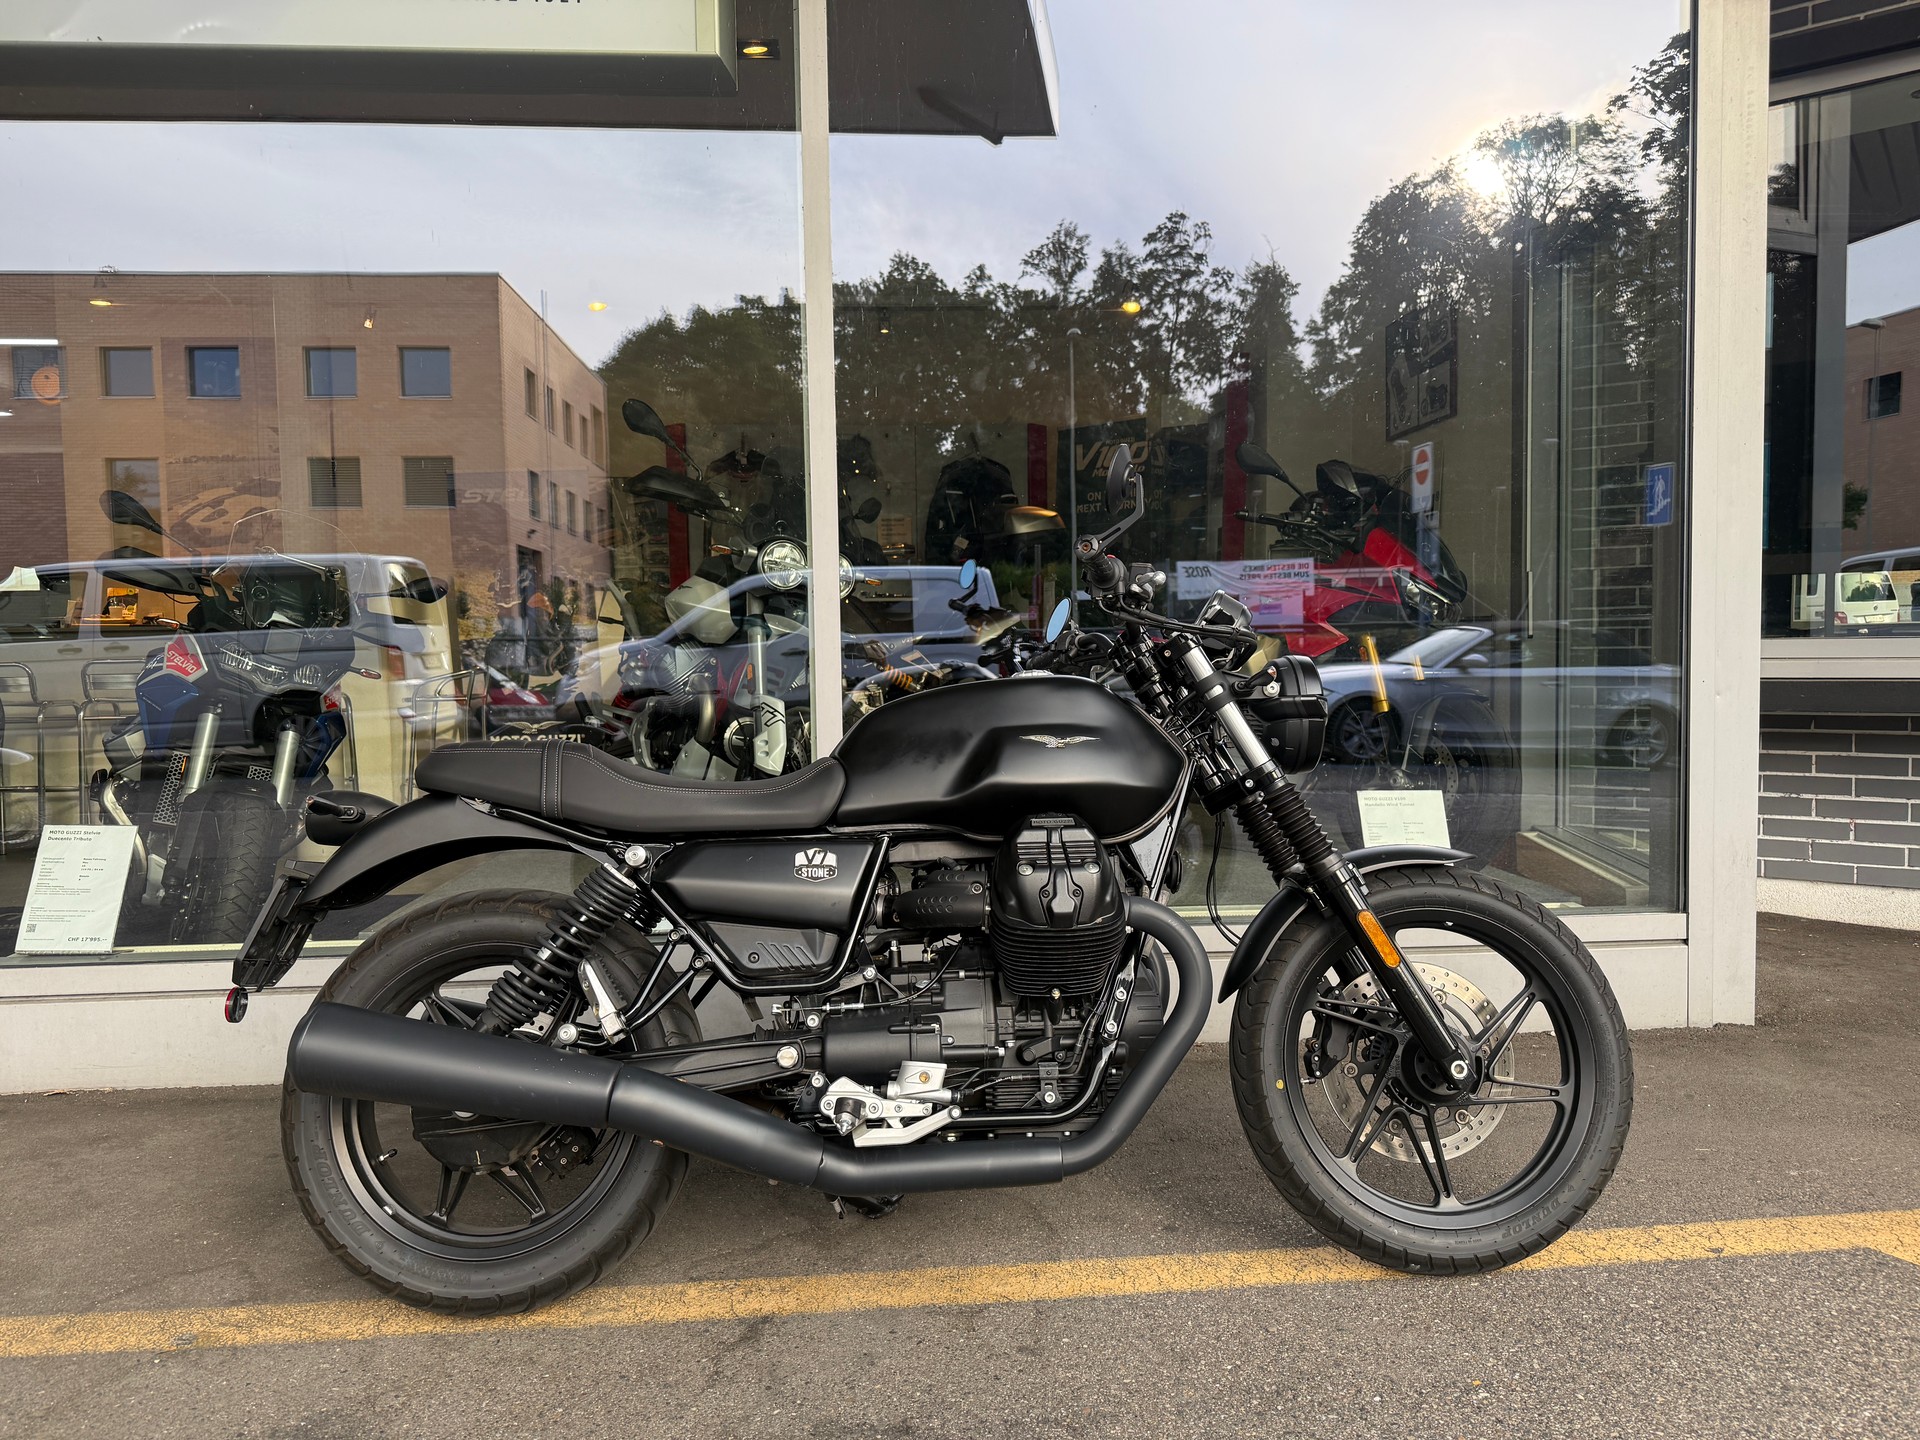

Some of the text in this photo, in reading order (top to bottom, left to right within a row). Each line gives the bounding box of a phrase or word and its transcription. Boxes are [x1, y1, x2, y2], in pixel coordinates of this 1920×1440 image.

[1087, 492, 1102, 501] ON
[166, 649, 197, 674] STELVIO
[803, 849, 830, 865] V7
[801, 867, 829, 878] STONE
[311, 1143, 373, 1236] DUNLOP
[1501, 1196, 1562, 1240] DUNLOP
